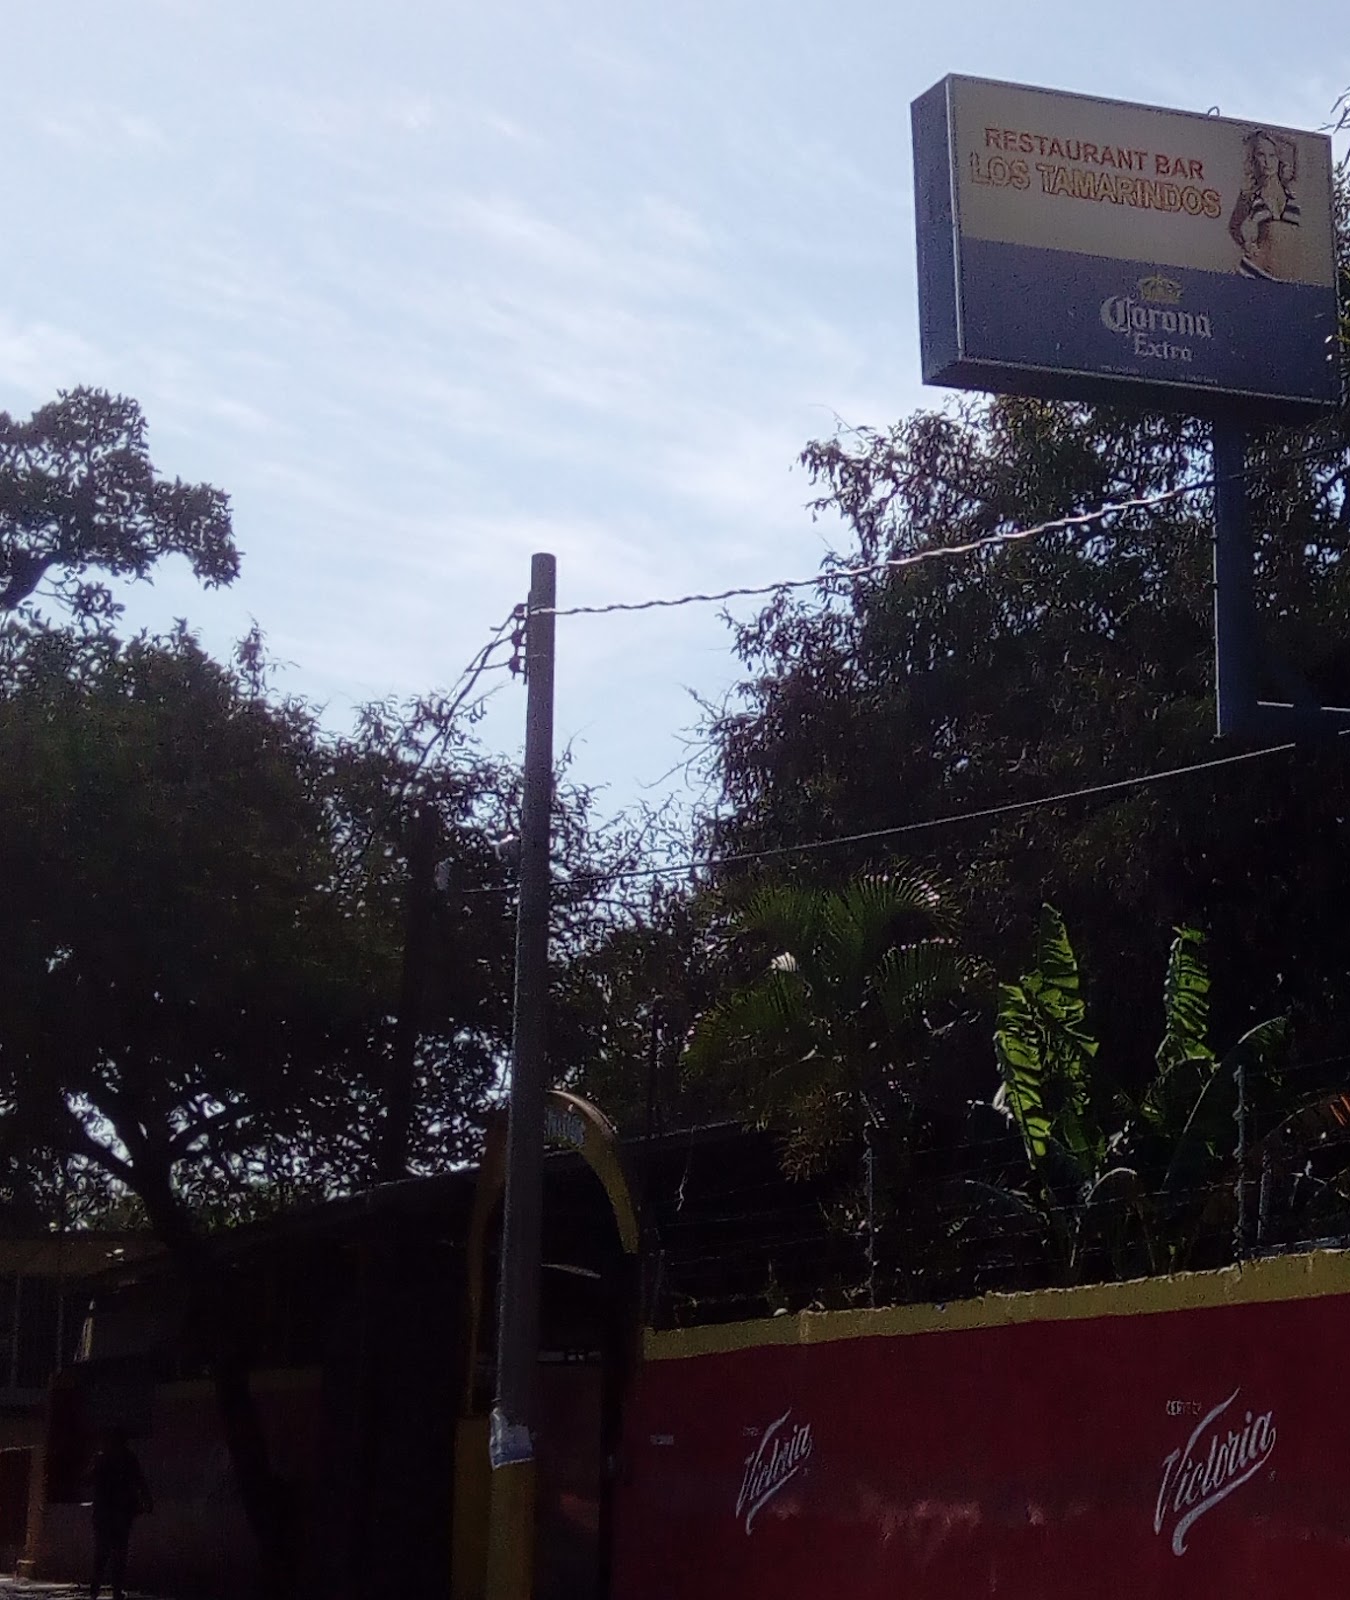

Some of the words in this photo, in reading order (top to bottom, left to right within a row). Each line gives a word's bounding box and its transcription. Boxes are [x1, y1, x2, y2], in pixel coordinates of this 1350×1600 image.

[984, 127, 1148, 171] RESTAURANT
[1155, 154, 1204, 180] BAR
[970, 152, 1030, 190] LOS
[1036, 162, 1222, 219] TAMARINDOS
[1100, 295, 1215, 340] Corona
[1134, 332, 1193, 362] Extra
[1153, 1385, 1278, 1557] Victoria
